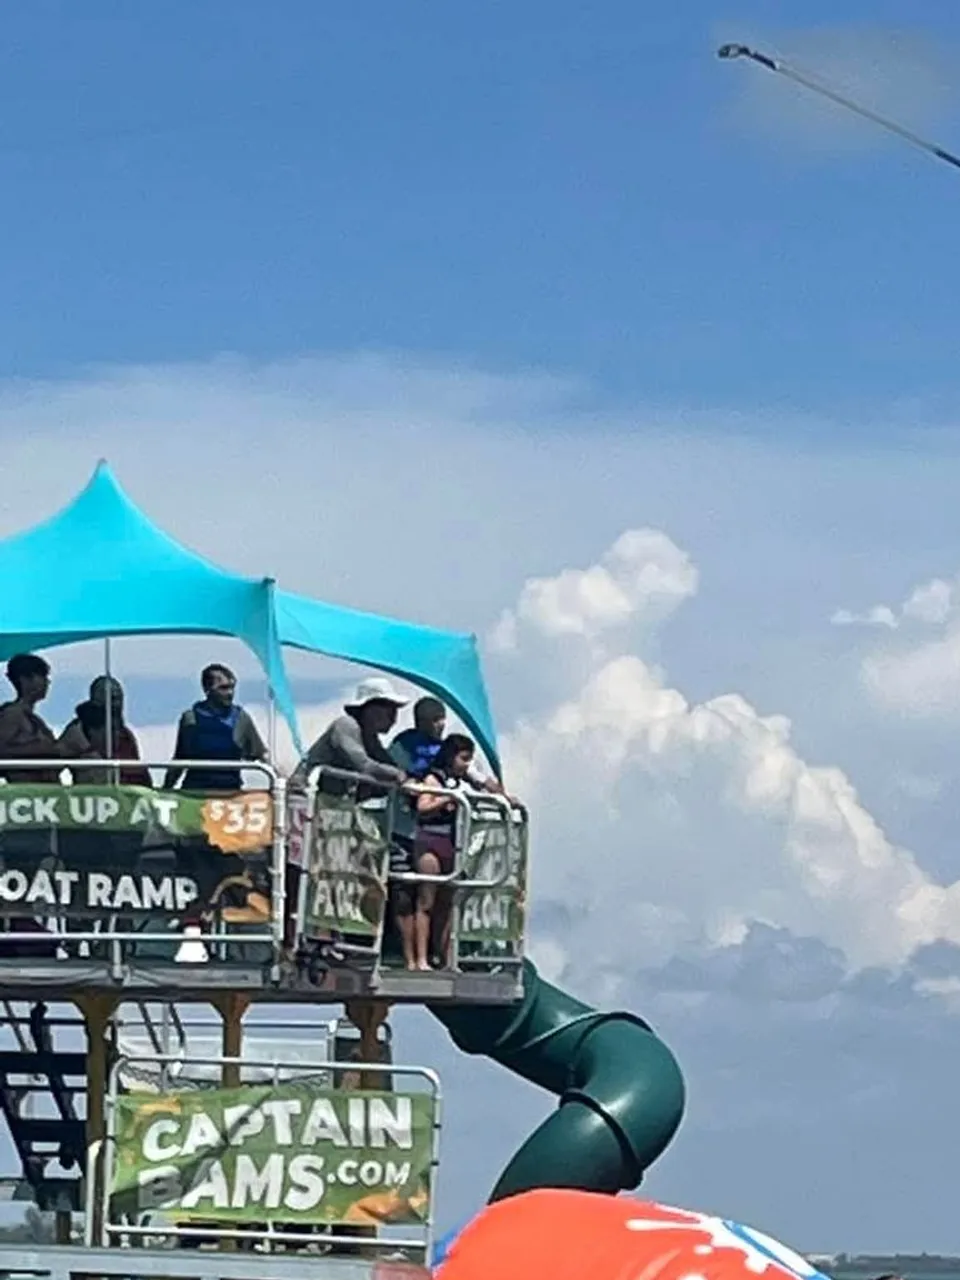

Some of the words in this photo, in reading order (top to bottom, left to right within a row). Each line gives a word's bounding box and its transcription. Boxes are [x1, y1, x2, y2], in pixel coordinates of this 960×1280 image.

[68, 797, 120, 824] UP
[130, 800, 178, 826] AT
[209, 801, 269, 834] $35
[87, 873, 198, 910] RAMP
[142, 1097, 413, 1162] CAPTAIN
